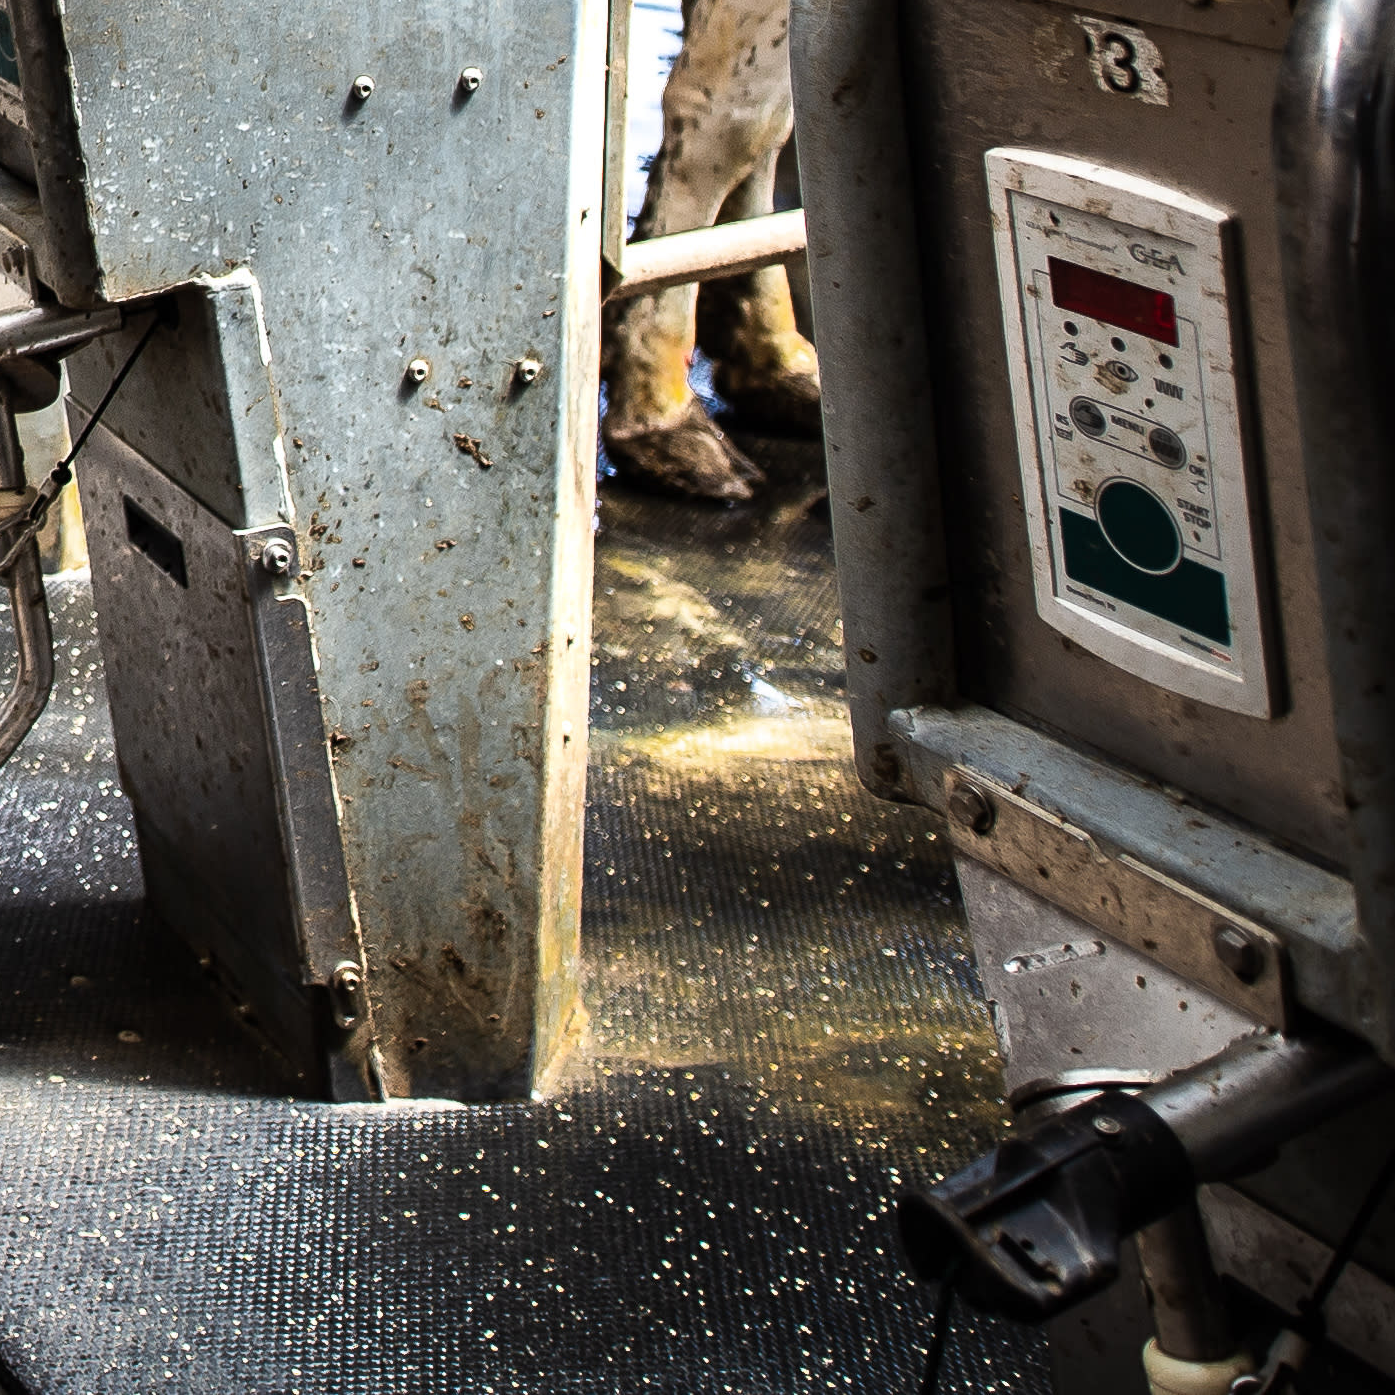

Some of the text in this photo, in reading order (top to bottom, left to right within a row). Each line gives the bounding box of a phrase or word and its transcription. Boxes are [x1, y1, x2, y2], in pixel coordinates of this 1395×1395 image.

[1103, 32, 1141, 93] 3
[1129, 243, 1186, 276] GEA
[1111, 415, 1145, 436] MENU
[1177, 498, 1210, 519] START
[1183, 512, 1212, 529] STOP
